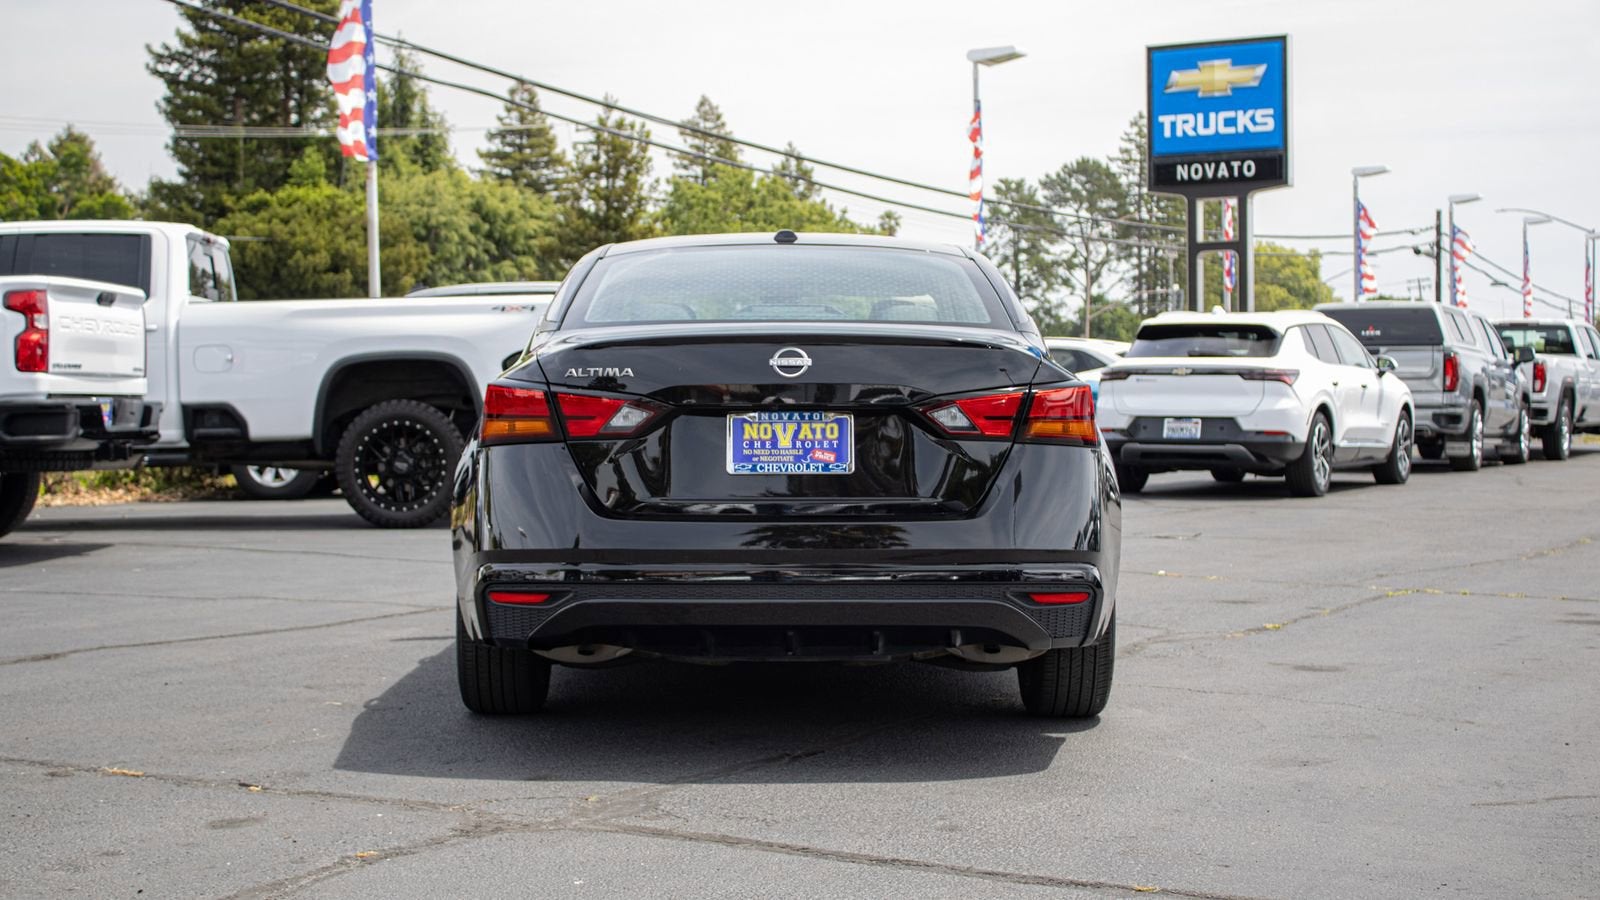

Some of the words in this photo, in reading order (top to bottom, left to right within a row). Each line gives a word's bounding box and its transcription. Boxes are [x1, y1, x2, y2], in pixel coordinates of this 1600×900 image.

[1158, 108, 1275, 138] TRUCKS
[1176, 160, 1256, 181] NOVATO
[769, 358, 812, 366] NISSAN
[564, 367, 634, 377] ALTIMA
[761, 412, 820, 420] NOVATO
[743, 423, 839, 447] NOVATO
[756, 463, 824, 472] CHEVROLET
